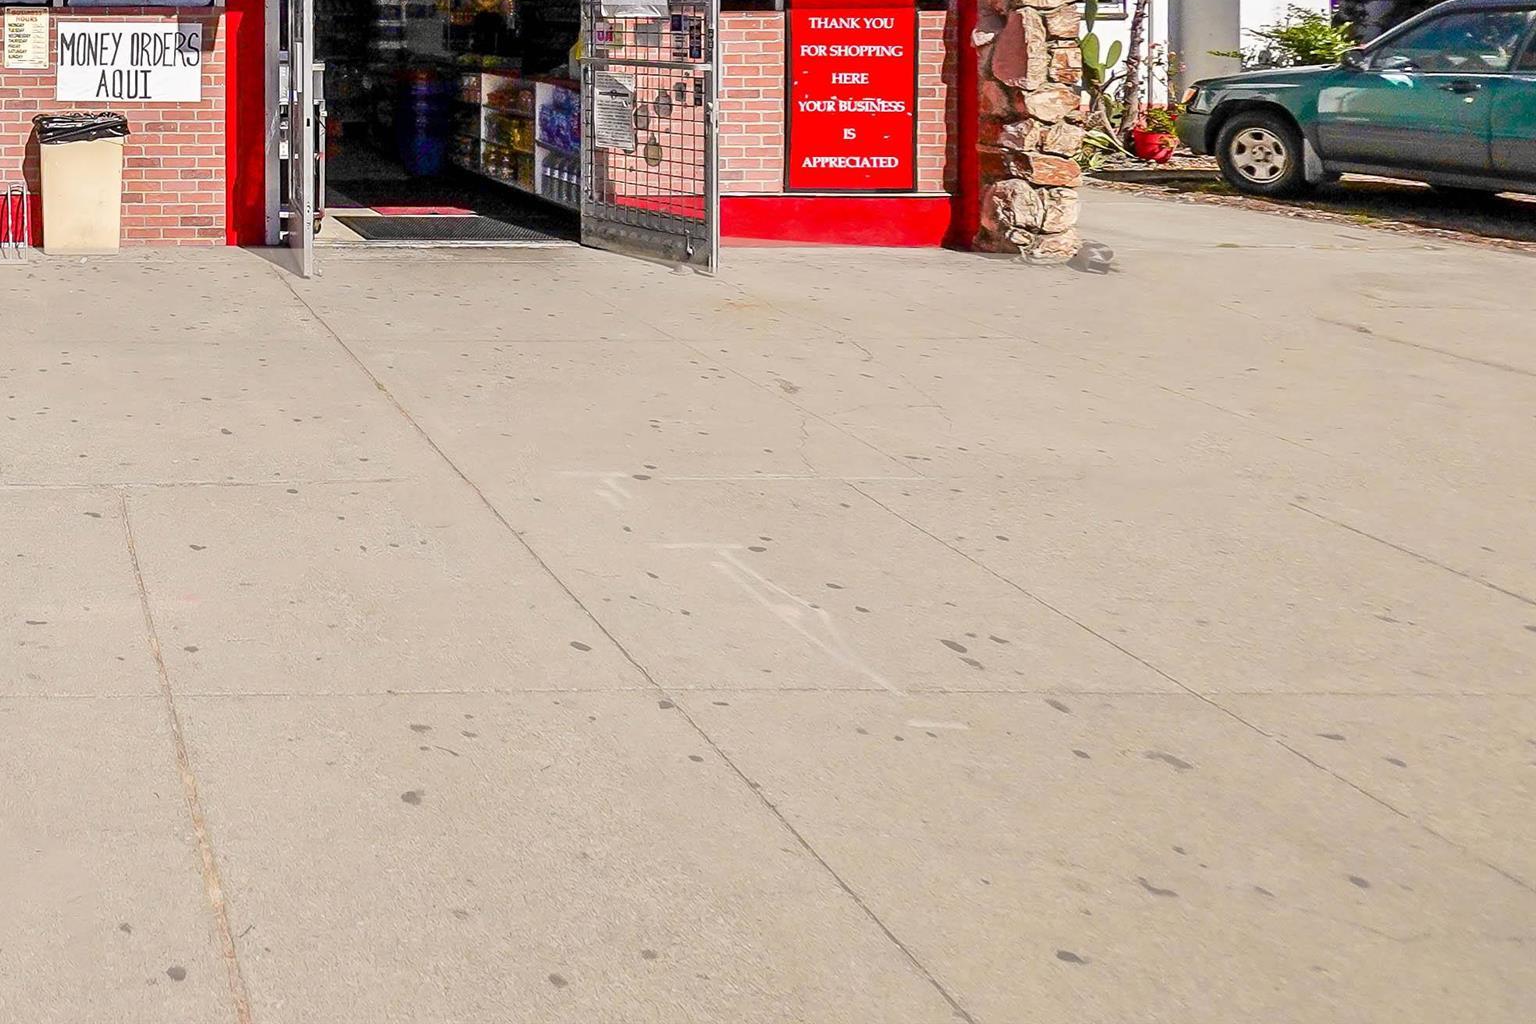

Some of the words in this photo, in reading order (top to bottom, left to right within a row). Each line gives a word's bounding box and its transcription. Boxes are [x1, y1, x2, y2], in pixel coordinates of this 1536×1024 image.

[808, 17, 860, 29] THANK
[863, 17, 894, 29] YOU
[60, 32, 122, 66] MONEY
[130, 32, 200, 67] ORDERS
[800, 45, 827, 56] FOR
[830, 45, 903, 57] SHOPPING
[96, 69, 152, 99] AQUI
[831, 73, 869, 84] HERE
[798, 101, 836, 112] YOUR
[839, 100, 905, 112] BUSINESS
[843, 128, 856, 139] IS
[802, 157, 899, 168] APPRECIATED
